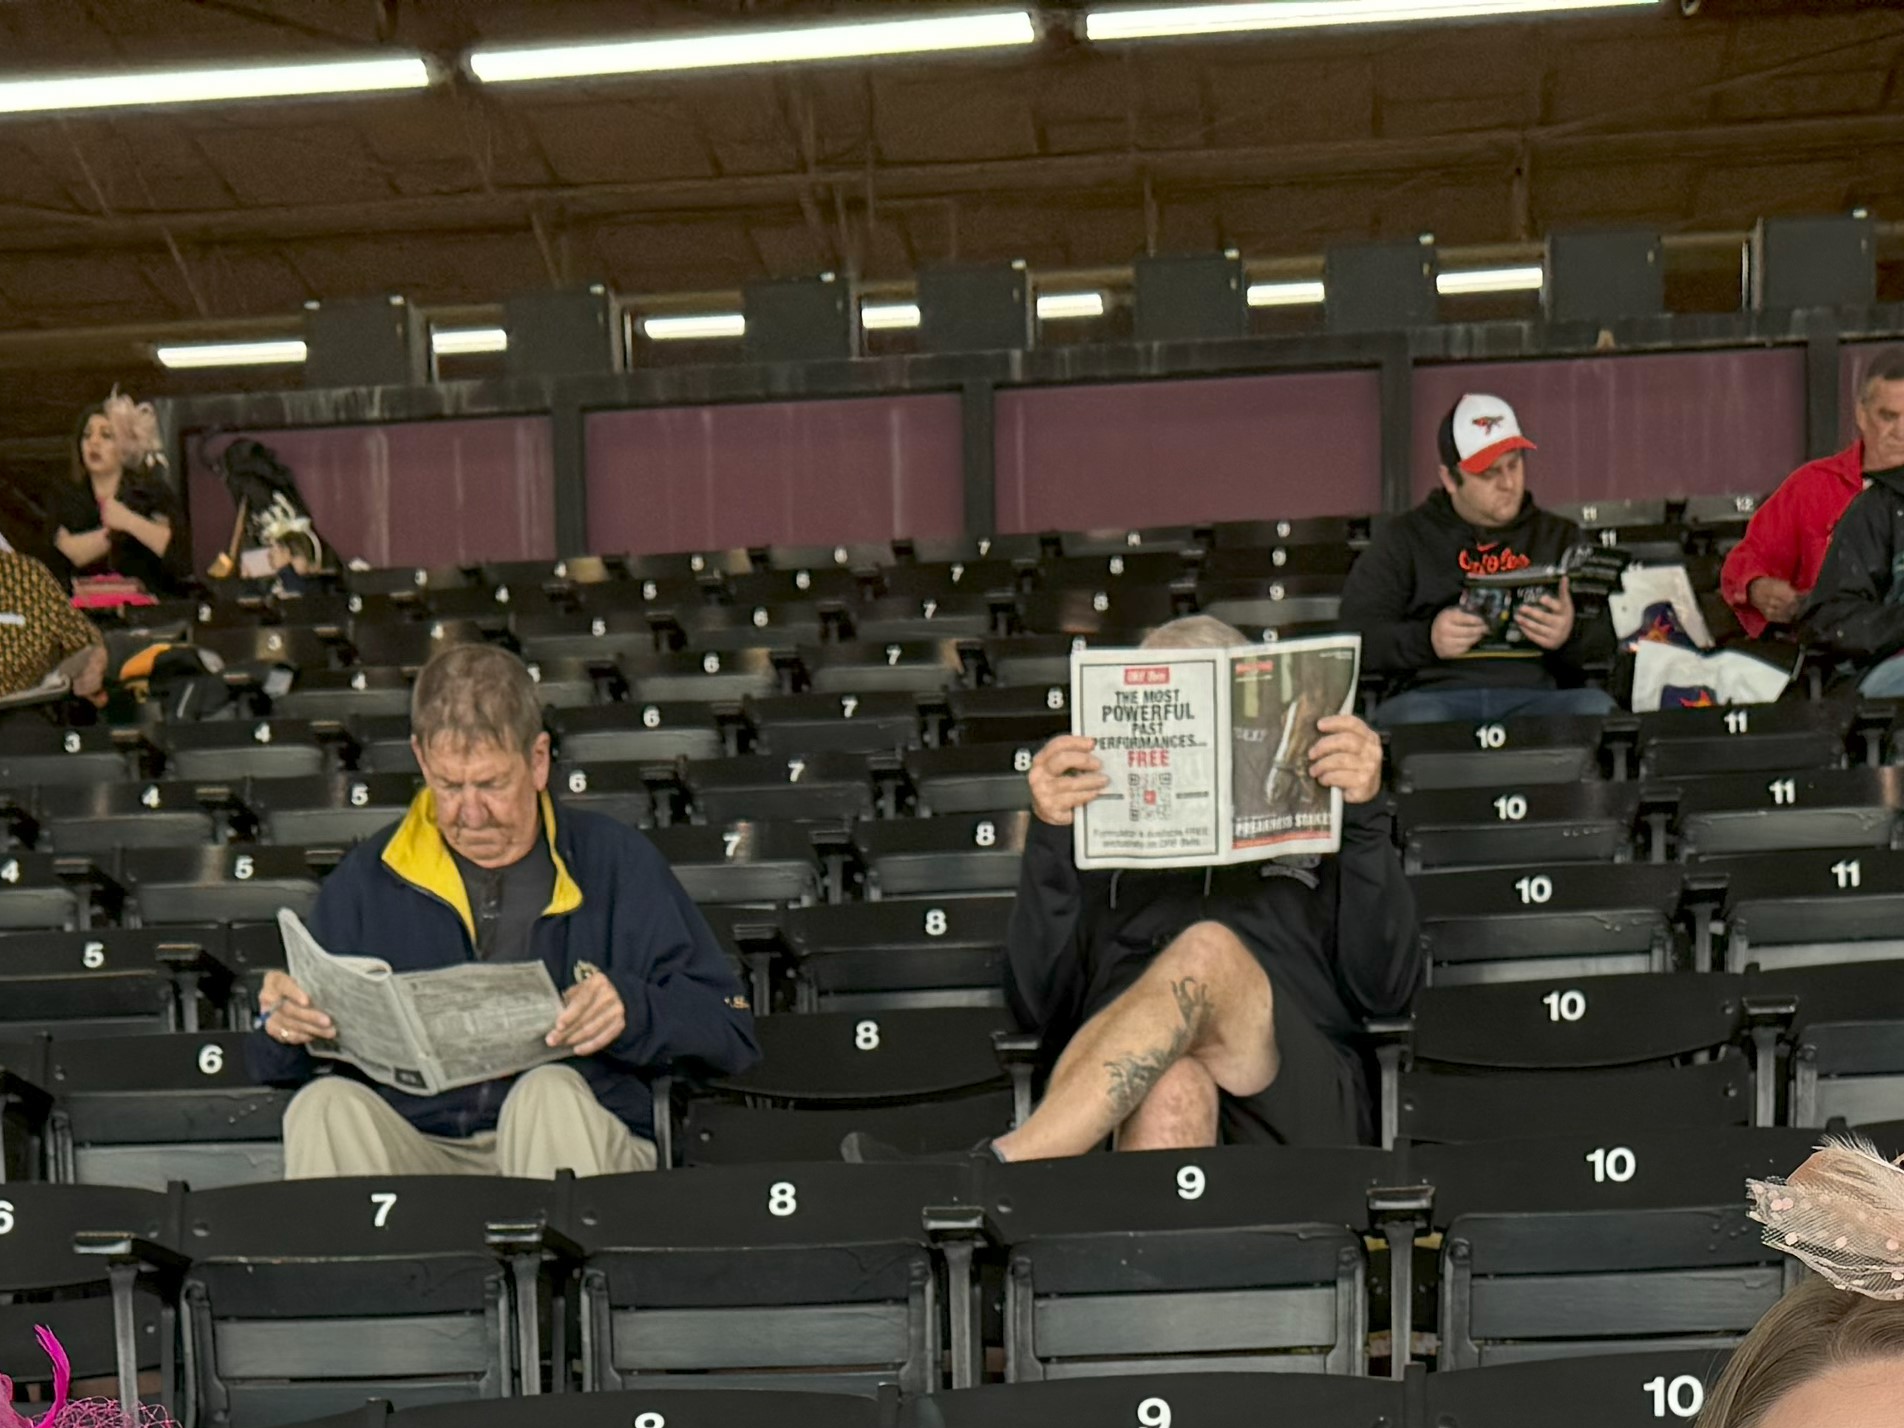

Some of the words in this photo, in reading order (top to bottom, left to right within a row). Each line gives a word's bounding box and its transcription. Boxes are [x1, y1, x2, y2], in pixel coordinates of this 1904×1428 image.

[753, 610, 768, 627] 6
[923, 602, 937, 620] 7
[592, 620, 606, 637] 5
[703, 655, 720, 673] 6
[886, 647, 901, 666] 7
[841, 697, 858, 718] 7
[1047, 689, 1064, 709] 8
[1114, 691, 1138, 704] THE
[1144, 689, 1180, 703] MOST
[643, 707, 661, 728] 6
[1102, 703, 1195, 723] POWERFUL
[1724, 711, 1748, 734] 11
[254, 723, 271, 743] 4
[1131, 722, 1163, 736] PAST
[1476, 725, 1506, 749] 10
[64, 733, 81, 753] 3
[787, 760, 805, 782] 7
[1014, 750, 1032, 771] 8
[1127, 750, 1171, 769] FREE
[568, 771, 587, 793] 6
[1769, 779, 1795, 805] 11
[142, 787, 160, 807] 4
[351, 784, 369, 806] 5
[1493, 795, 1527, 820] 10
[721, 831, 740, 858] 7
[975, 822, 996, 846] 8
[0, 860, 20, 883] 4
[234, 856, 253, 880] 5
[1831, 861, 1860, 888] 11
[1515, 876, 1553, 904] 10
[925, 909, 947, 936] 8
[83, 942, 105, 969] 5
[1543, 990, 1586, 1022] 10
[855, 1020, 880, 1051] 8
[198, 1044, 223, 1074] 6
[1585, 1146, 1636, 1183] 10
[1176, 1165, 1206, 1200] 9
[370, 1192, 398, 1227] 7
[768, 1181, 797, 1217] 8
[1643, 1374, 1705, 1418] 10
